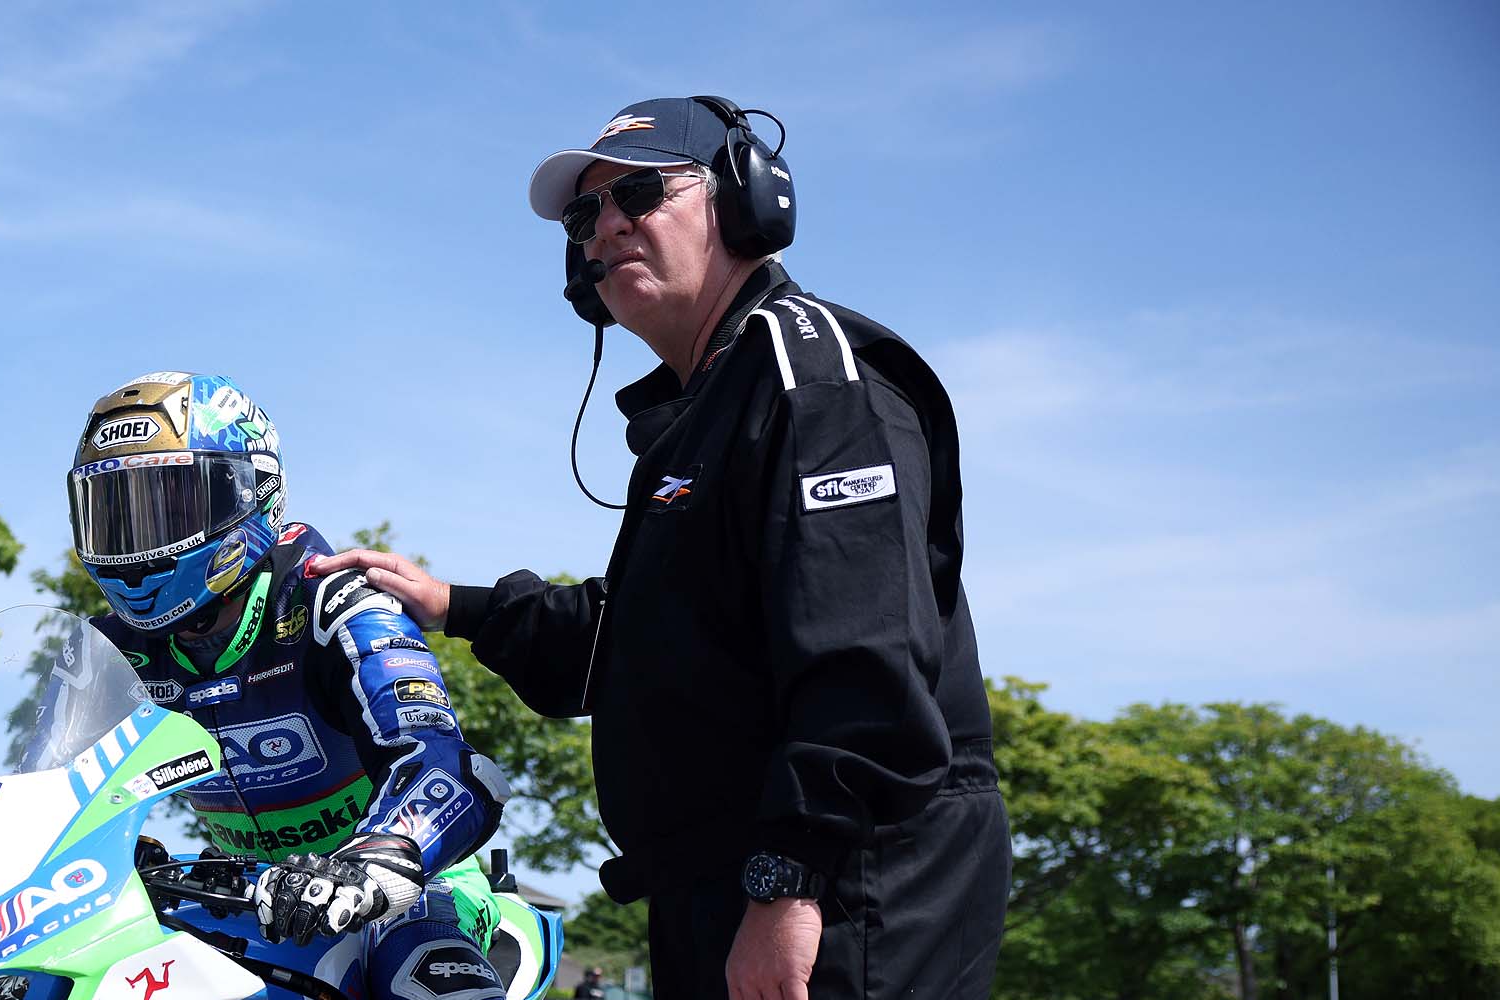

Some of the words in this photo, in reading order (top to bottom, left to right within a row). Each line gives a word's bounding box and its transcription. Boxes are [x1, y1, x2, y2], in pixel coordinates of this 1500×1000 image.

[99, 421, 149, 444] SHOEI
[256, 477, 279, 498] SHOEI
[235, 596, 264, 653] spada
[247, 661, 295, 683] HARRISON
[189, 682, 238, 702] spada
[1, 892, 112, 958] RACING
[428, 961, 496, 982] spada
